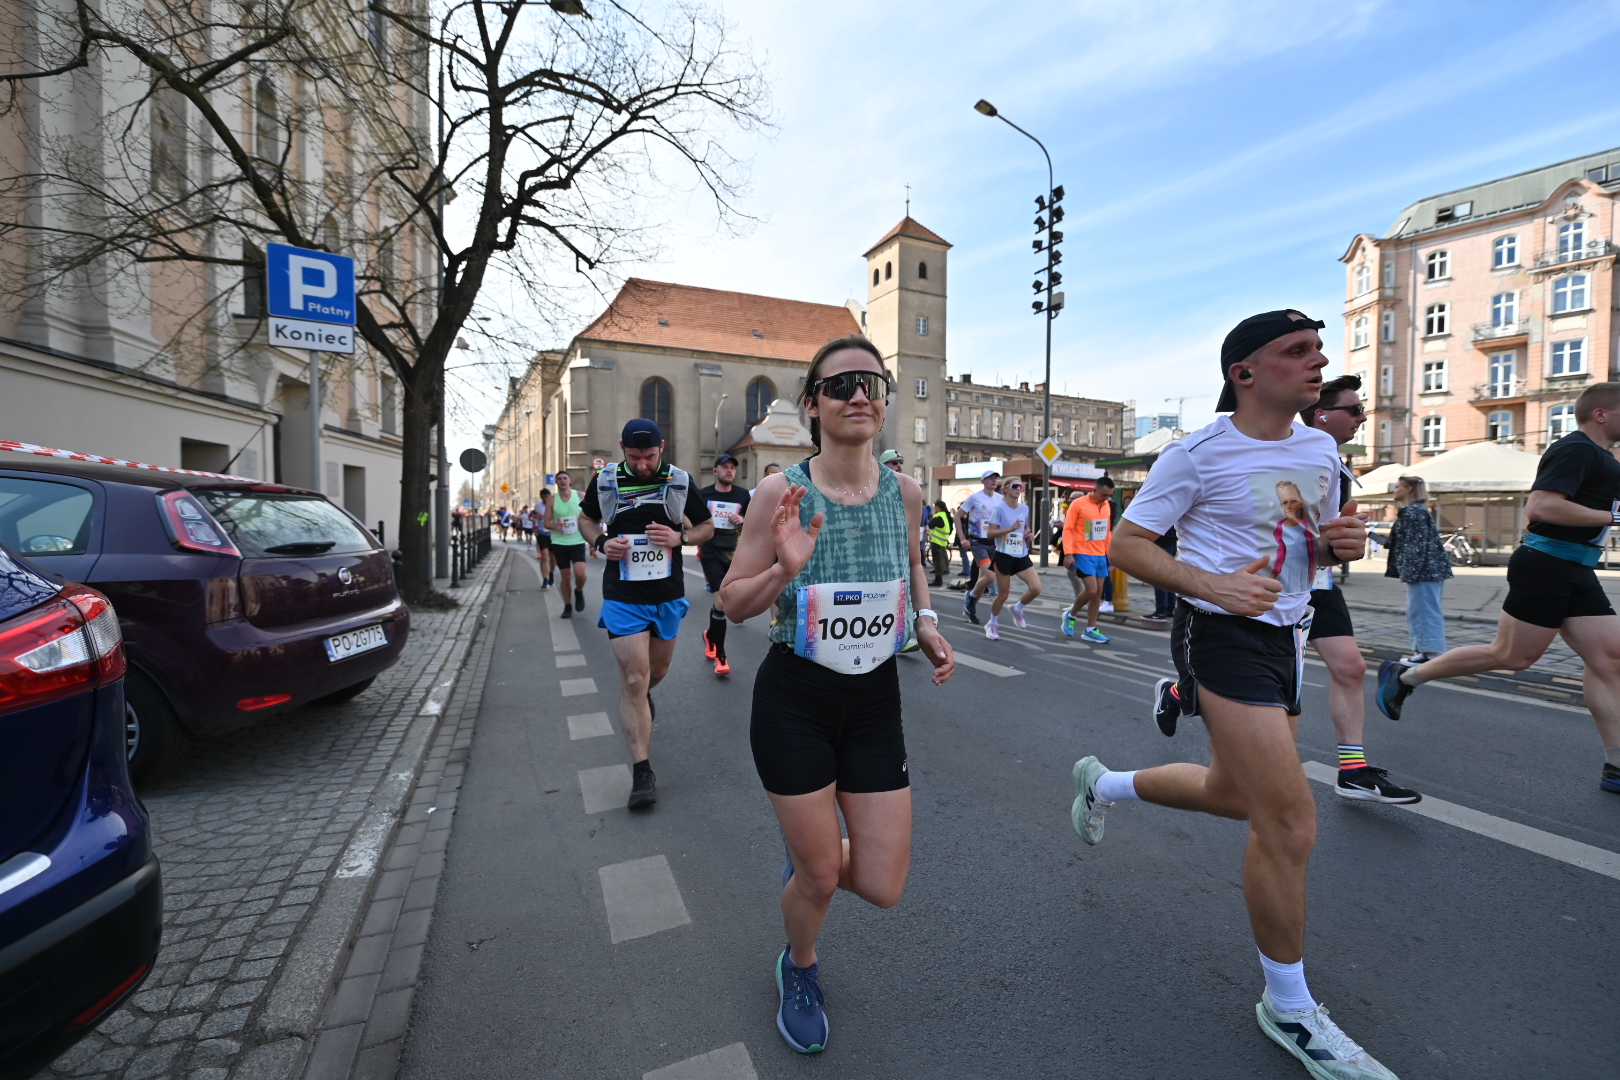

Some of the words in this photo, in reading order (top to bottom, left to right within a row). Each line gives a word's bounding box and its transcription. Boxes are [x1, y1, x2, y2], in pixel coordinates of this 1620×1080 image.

[288, 253, 338, 311] P
[308, 302, 351, 319] Płatny
[275, 324, 347, 346] Koniec
[631, 550, 664, 563] 8706
[818, 613, 895, 640] 10069
[331, 635, 352, 655] PO
[352, 625, 384, 648] 2G775
[838, 642, 875, 652] Dominika
